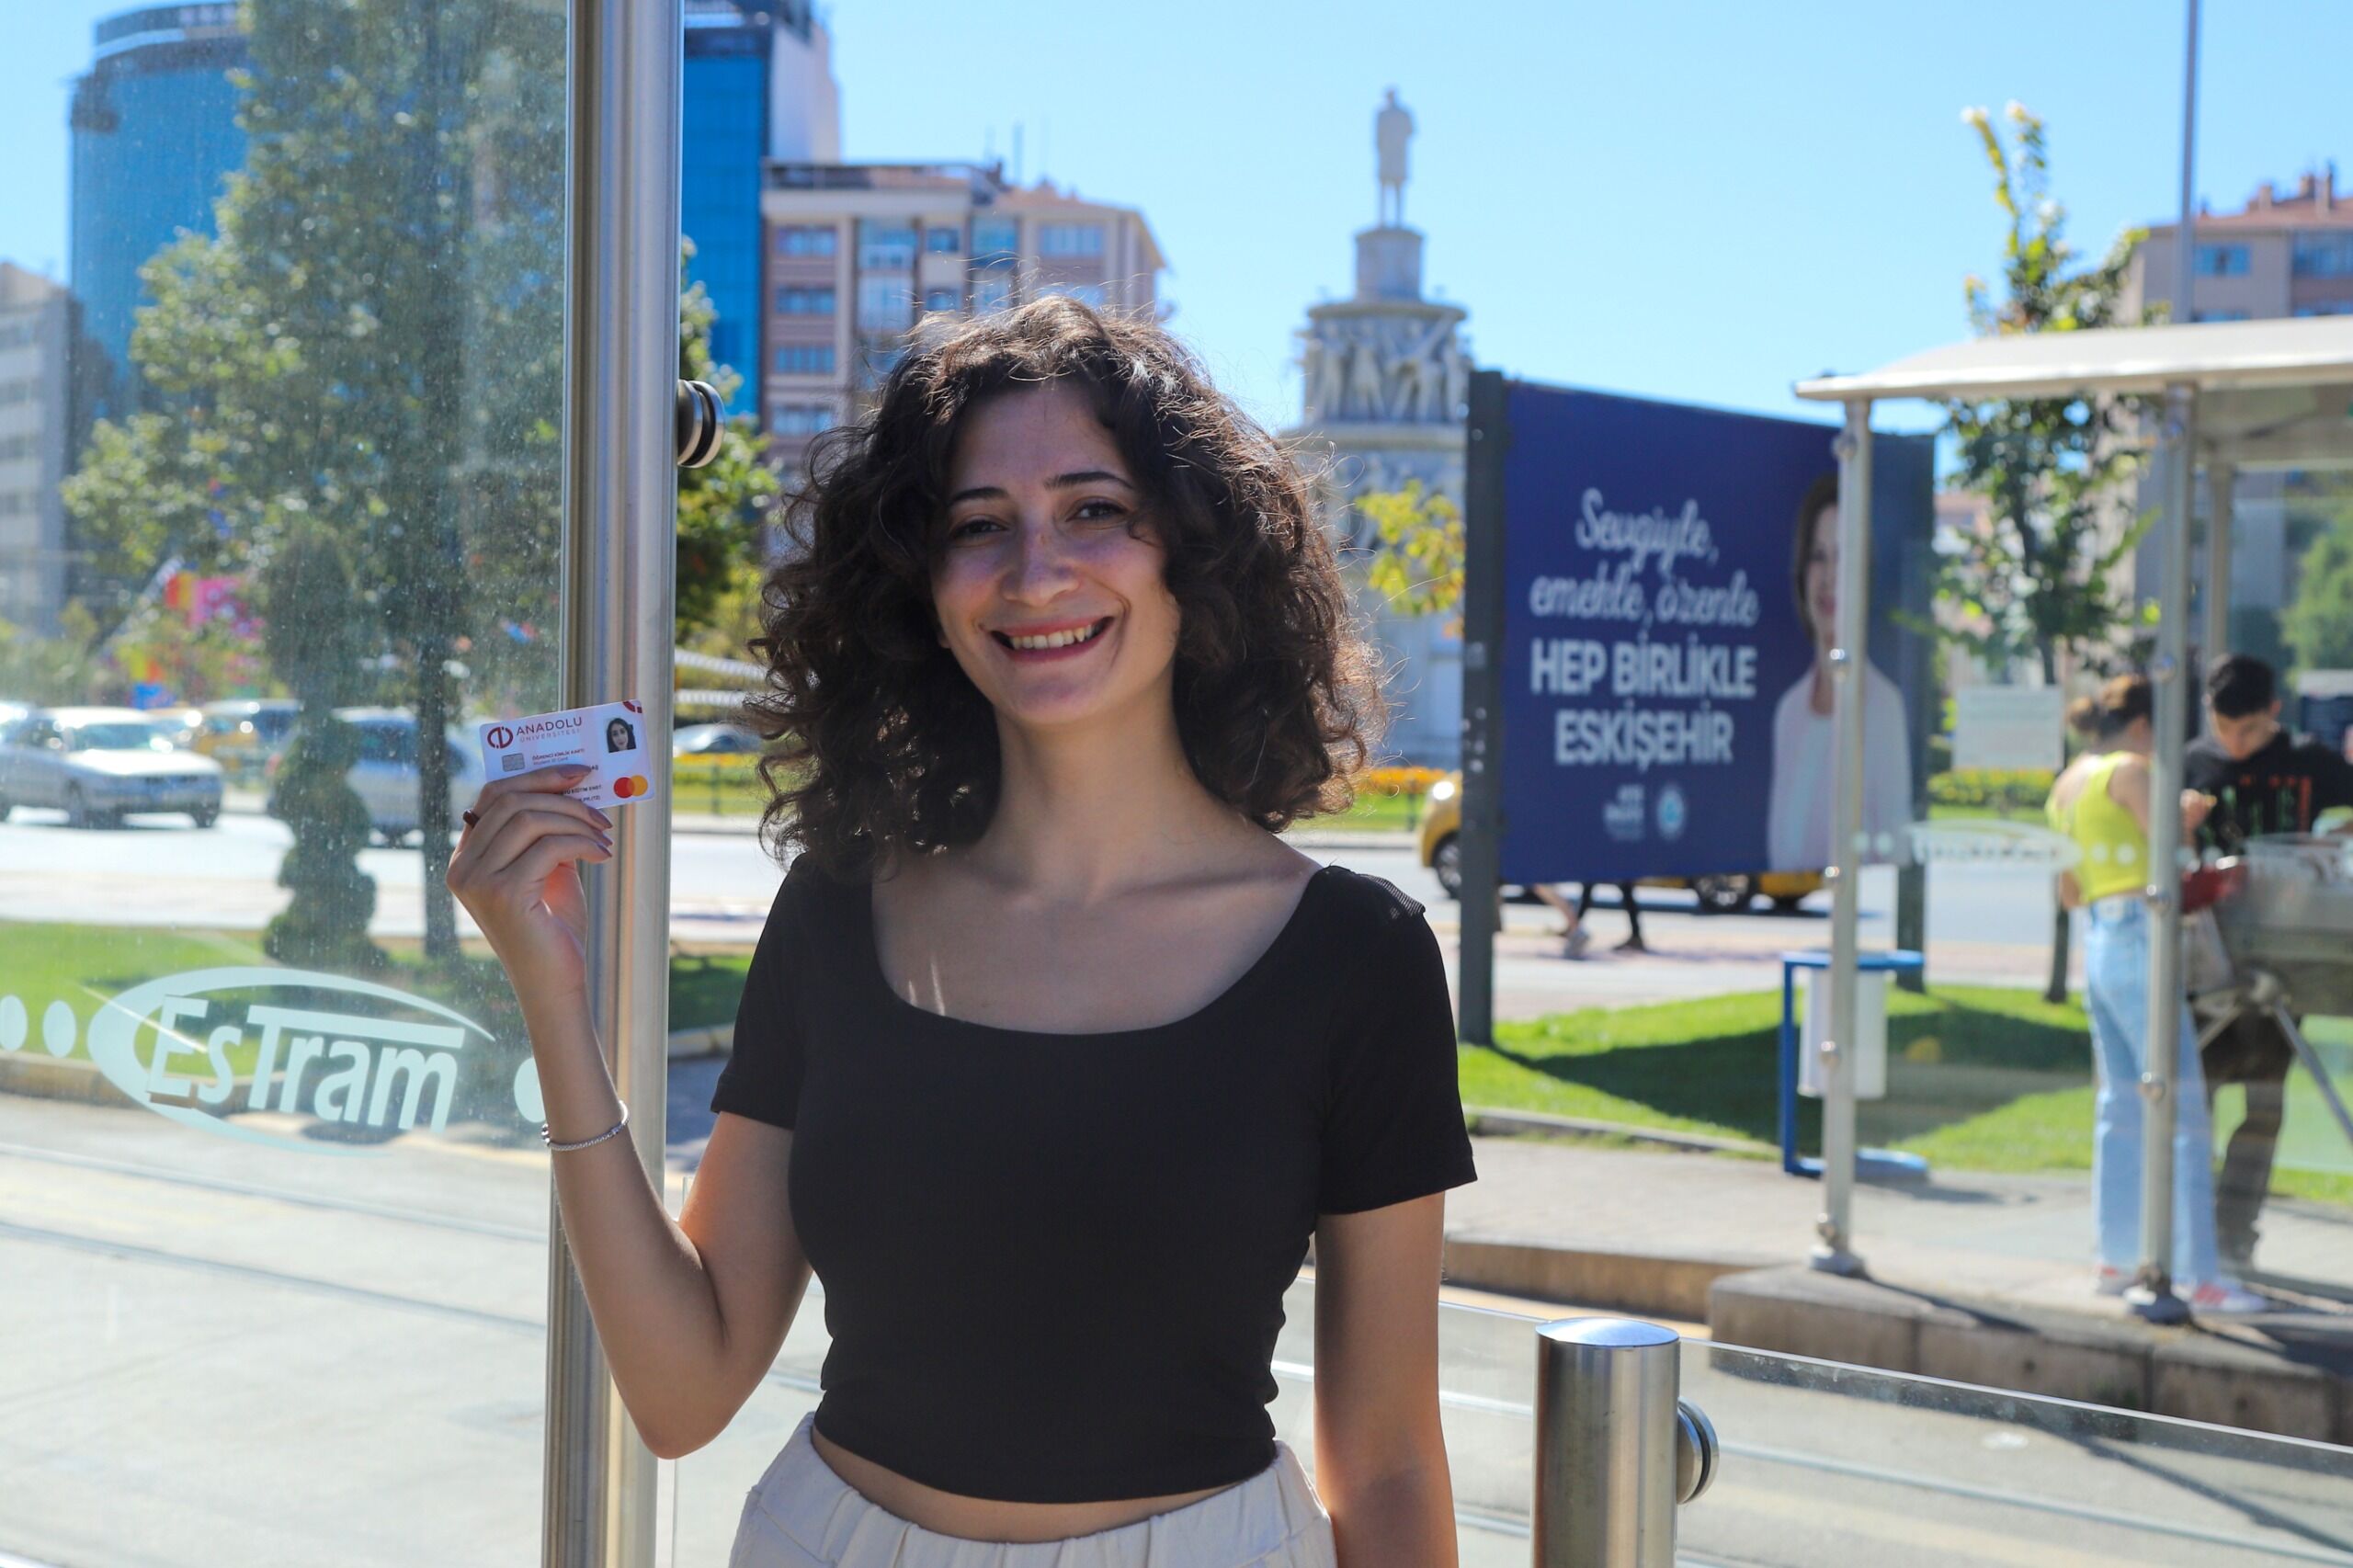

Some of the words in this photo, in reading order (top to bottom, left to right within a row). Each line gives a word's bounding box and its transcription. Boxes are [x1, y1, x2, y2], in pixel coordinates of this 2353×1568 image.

[1574, 486, 1719, 574] Sevgiyle,
[1529, 561, 1655, 631] emekle,
[1530, 636, 1606, 695] HEP
[1611, 631, 1757, 699] BİRLİKLE
[516, 716, 583, 736] ANADOLU
[1554, 699, 1734, 772] ESKİŞEHİR
[144, 994, 467, 1133] EsTram
